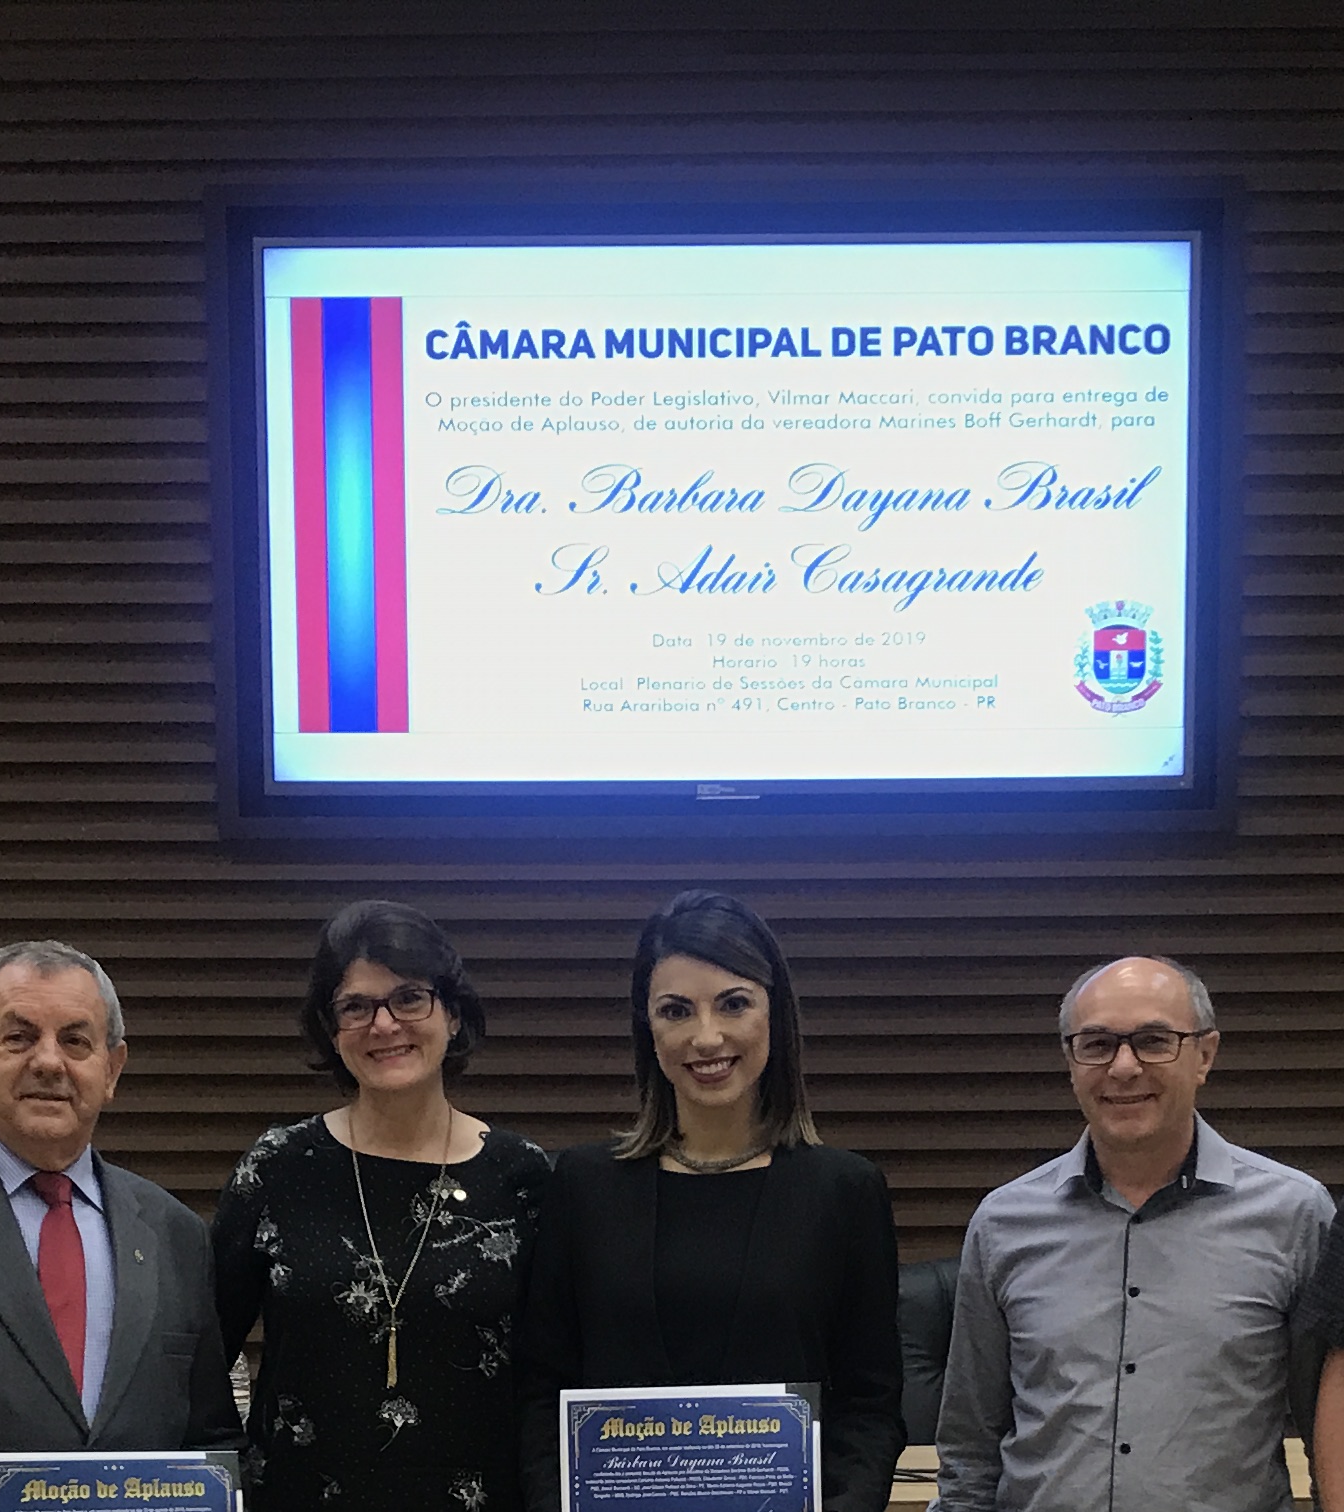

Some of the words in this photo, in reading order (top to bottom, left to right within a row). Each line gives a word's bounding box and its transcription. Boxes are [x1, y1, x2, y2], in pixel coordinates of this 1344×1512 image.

[425, 320, 596, 360] CÂMARA
[604, 326, 821, 359] MUNICIPAL
[831, 326, 882, 357] DE
[893, 325, 994, 356] PATO
[1004, 323, 1171, 355] BRANCO
[425, 392, 442, 408] O
[450, 391, 552, 411] presidente
[559, 391, 584, 407] do
[591, 390, 645, 407] Poder
[653, 390, 760, 410] Legislativo,
[768, 389, 830, 406] Vilmar
[838, 388, 920, 407] Maccari,
[928, 388, 1002, 405] convida
[1010, 389, 1055, 408] para
[1062, 387, 1138, 407] entrega
[1144, 386, 1169, 403] de
[437, 418, 503, 435] Moção
[510, 416, 534, 432] de
[541, 416, 625, 435] Aplauso,
[633, 415, 657, 431] de
[664, 415, 734, 431] autoria
[741, 413, 765, 430] da
[772, 413, 871, 430] vereadora
[879, 413, 956, 429] Marines
[964, 411, 1001, 429] Boff
[1008, 411, 1102, 430] Gerhardt,
[1110, 412, 1155, 431] para
[436, 465, 547, 515] Dra.
[568, 463, 766, 515] Barbara
[778, 462, 972, 533] Dayana
[984, 460, 1163, 512] Brasil
[534, 543, 610, 596] Sr.
[629, 543, 778, 596] Adair
[790, 543, 1045, 614] Casagrande
[707, 632, 727, 647] 19
[734, 632, 755, 647] de
[761, 632, 847, 647] novembro
[854, 631, 875, 646] de
[881, 631, 926, 646] 2019
[792, 654, 811, 668] 19
[818, 653, 866, 668] horas
[712, 675, 734, 690] de
[740, 674, 806, 690] Sessões
[811, 675, 833, 690] da
[915, 673, 999, 692] Municipal
[582, 699, 614, 713] Rua
[619, 697, 699, 712] Arariboia
[731, 697, 770, 714] 491,
[777, 696, 835, 712] Centro
[854, 697, 891, 711] Pato
[897, 696, 956, 711] Branco
[976, 695, 997, 710] PR
[600, 1416, 666, 1441] Moção
[671, 1417, 693, 1436] de
[698, 1413, 781, 1438] Aplauso
[727, 1451, 777, 1466] Brasil
[20, 1478, 91, 1503] Moção
[96, 1480, 119, 1499] de
[123, 1477, 206, 1501] Aplauso
